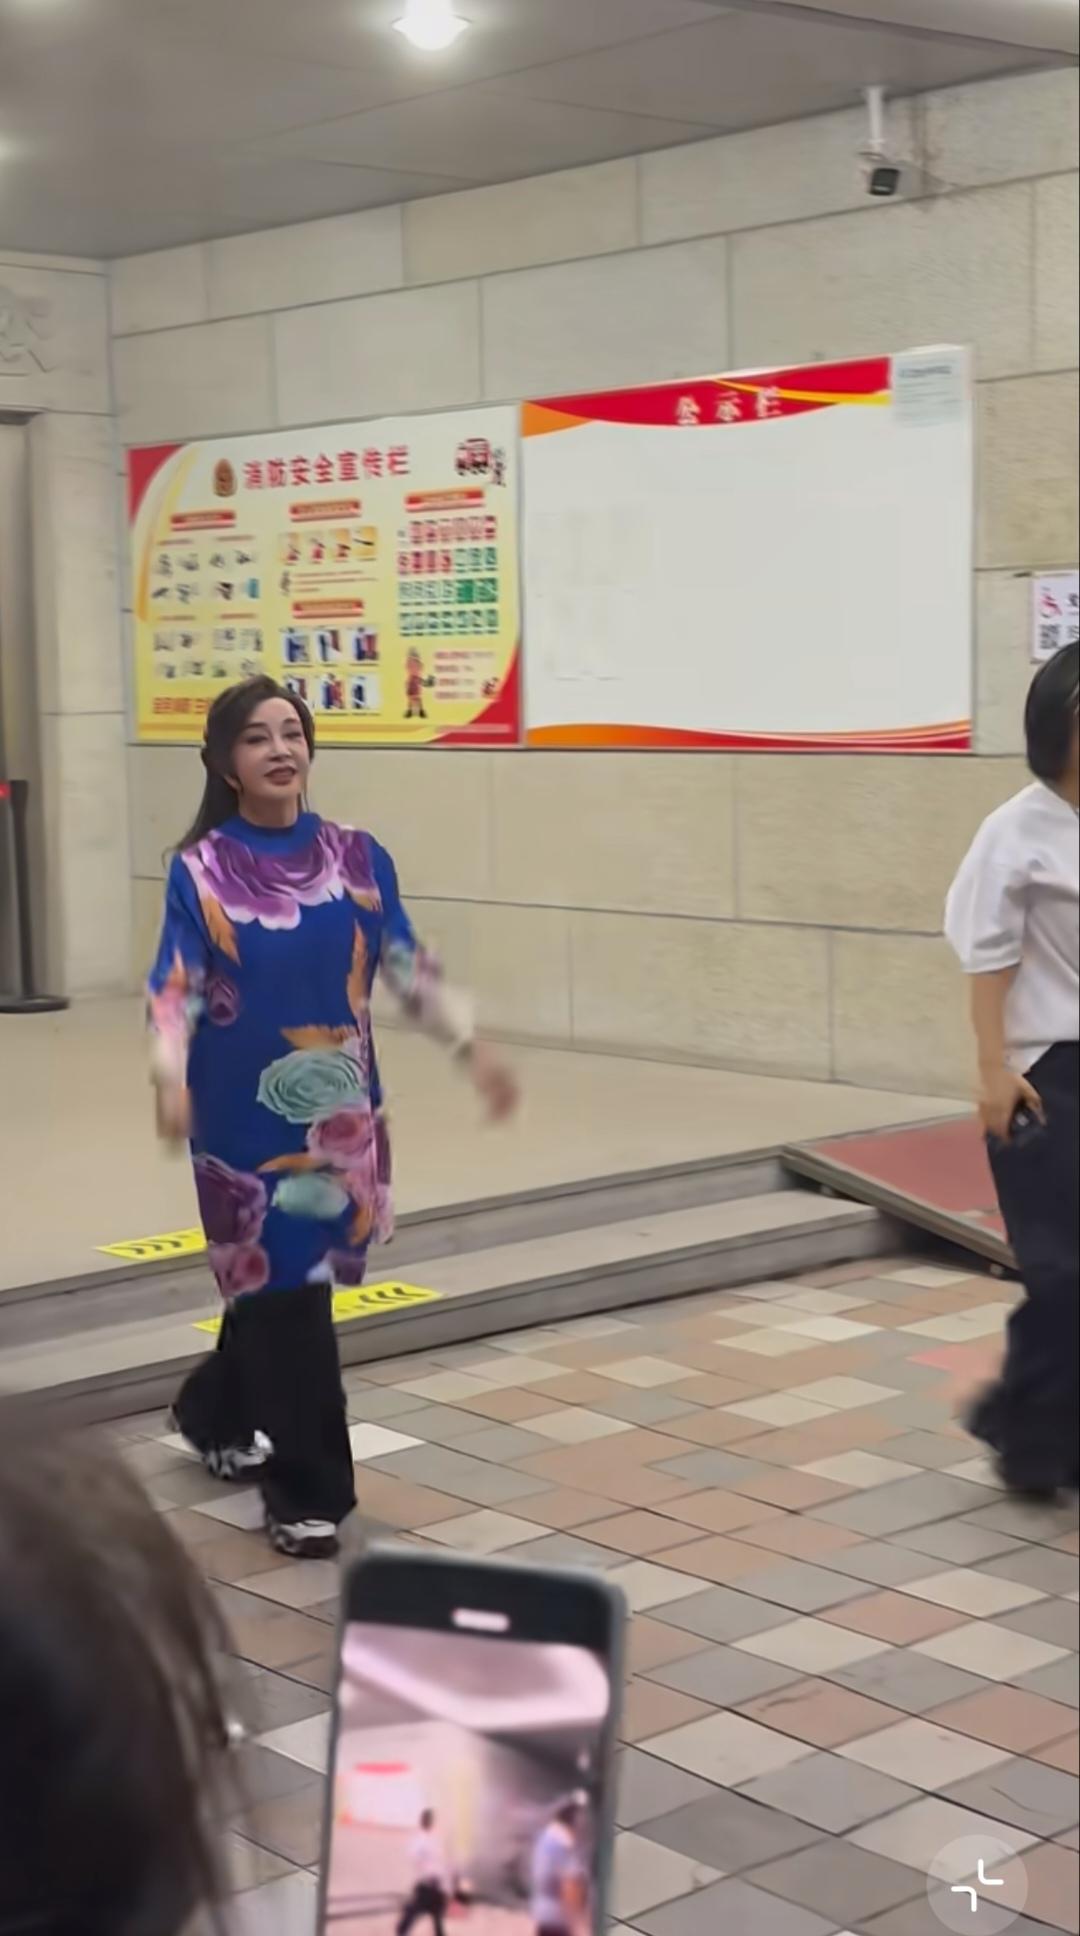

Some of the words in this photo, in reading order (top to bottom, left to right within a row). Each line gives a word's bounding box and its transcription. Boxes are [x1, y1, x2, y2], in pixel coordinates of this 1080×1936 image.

[674, 386, 782, 426] 公示栏
[243, 445, 411, 490] 消防安全宣传栏
